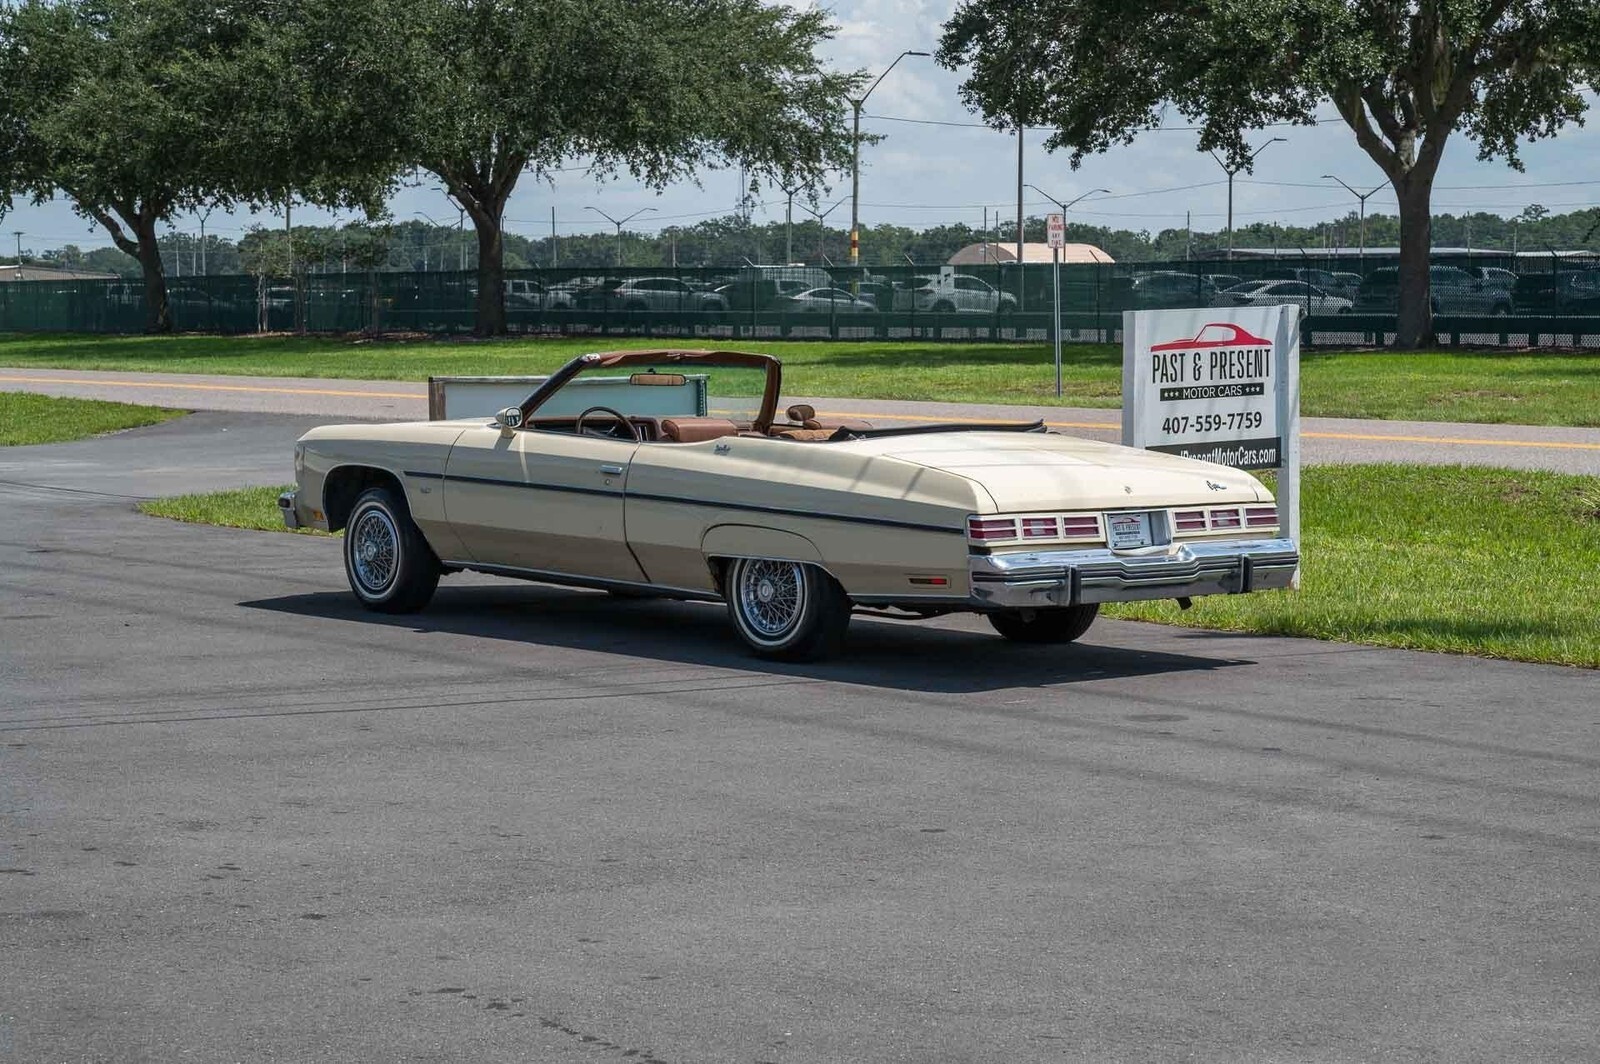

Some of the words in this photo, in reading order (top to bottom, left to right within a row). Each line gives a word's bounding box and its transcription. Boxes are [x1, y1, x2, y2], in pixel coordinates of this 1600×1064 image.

[1152, 353, 1185, 383] PAST
[1193, 352, 1203, 381] &
[1210, 349, 1271, 380] PRESENT
[1182, 387, 1216, 399] MOTOR
[1217, 385, 1243, 397] CARS
[1162, 411, 1262, 434] 407-559-7759
